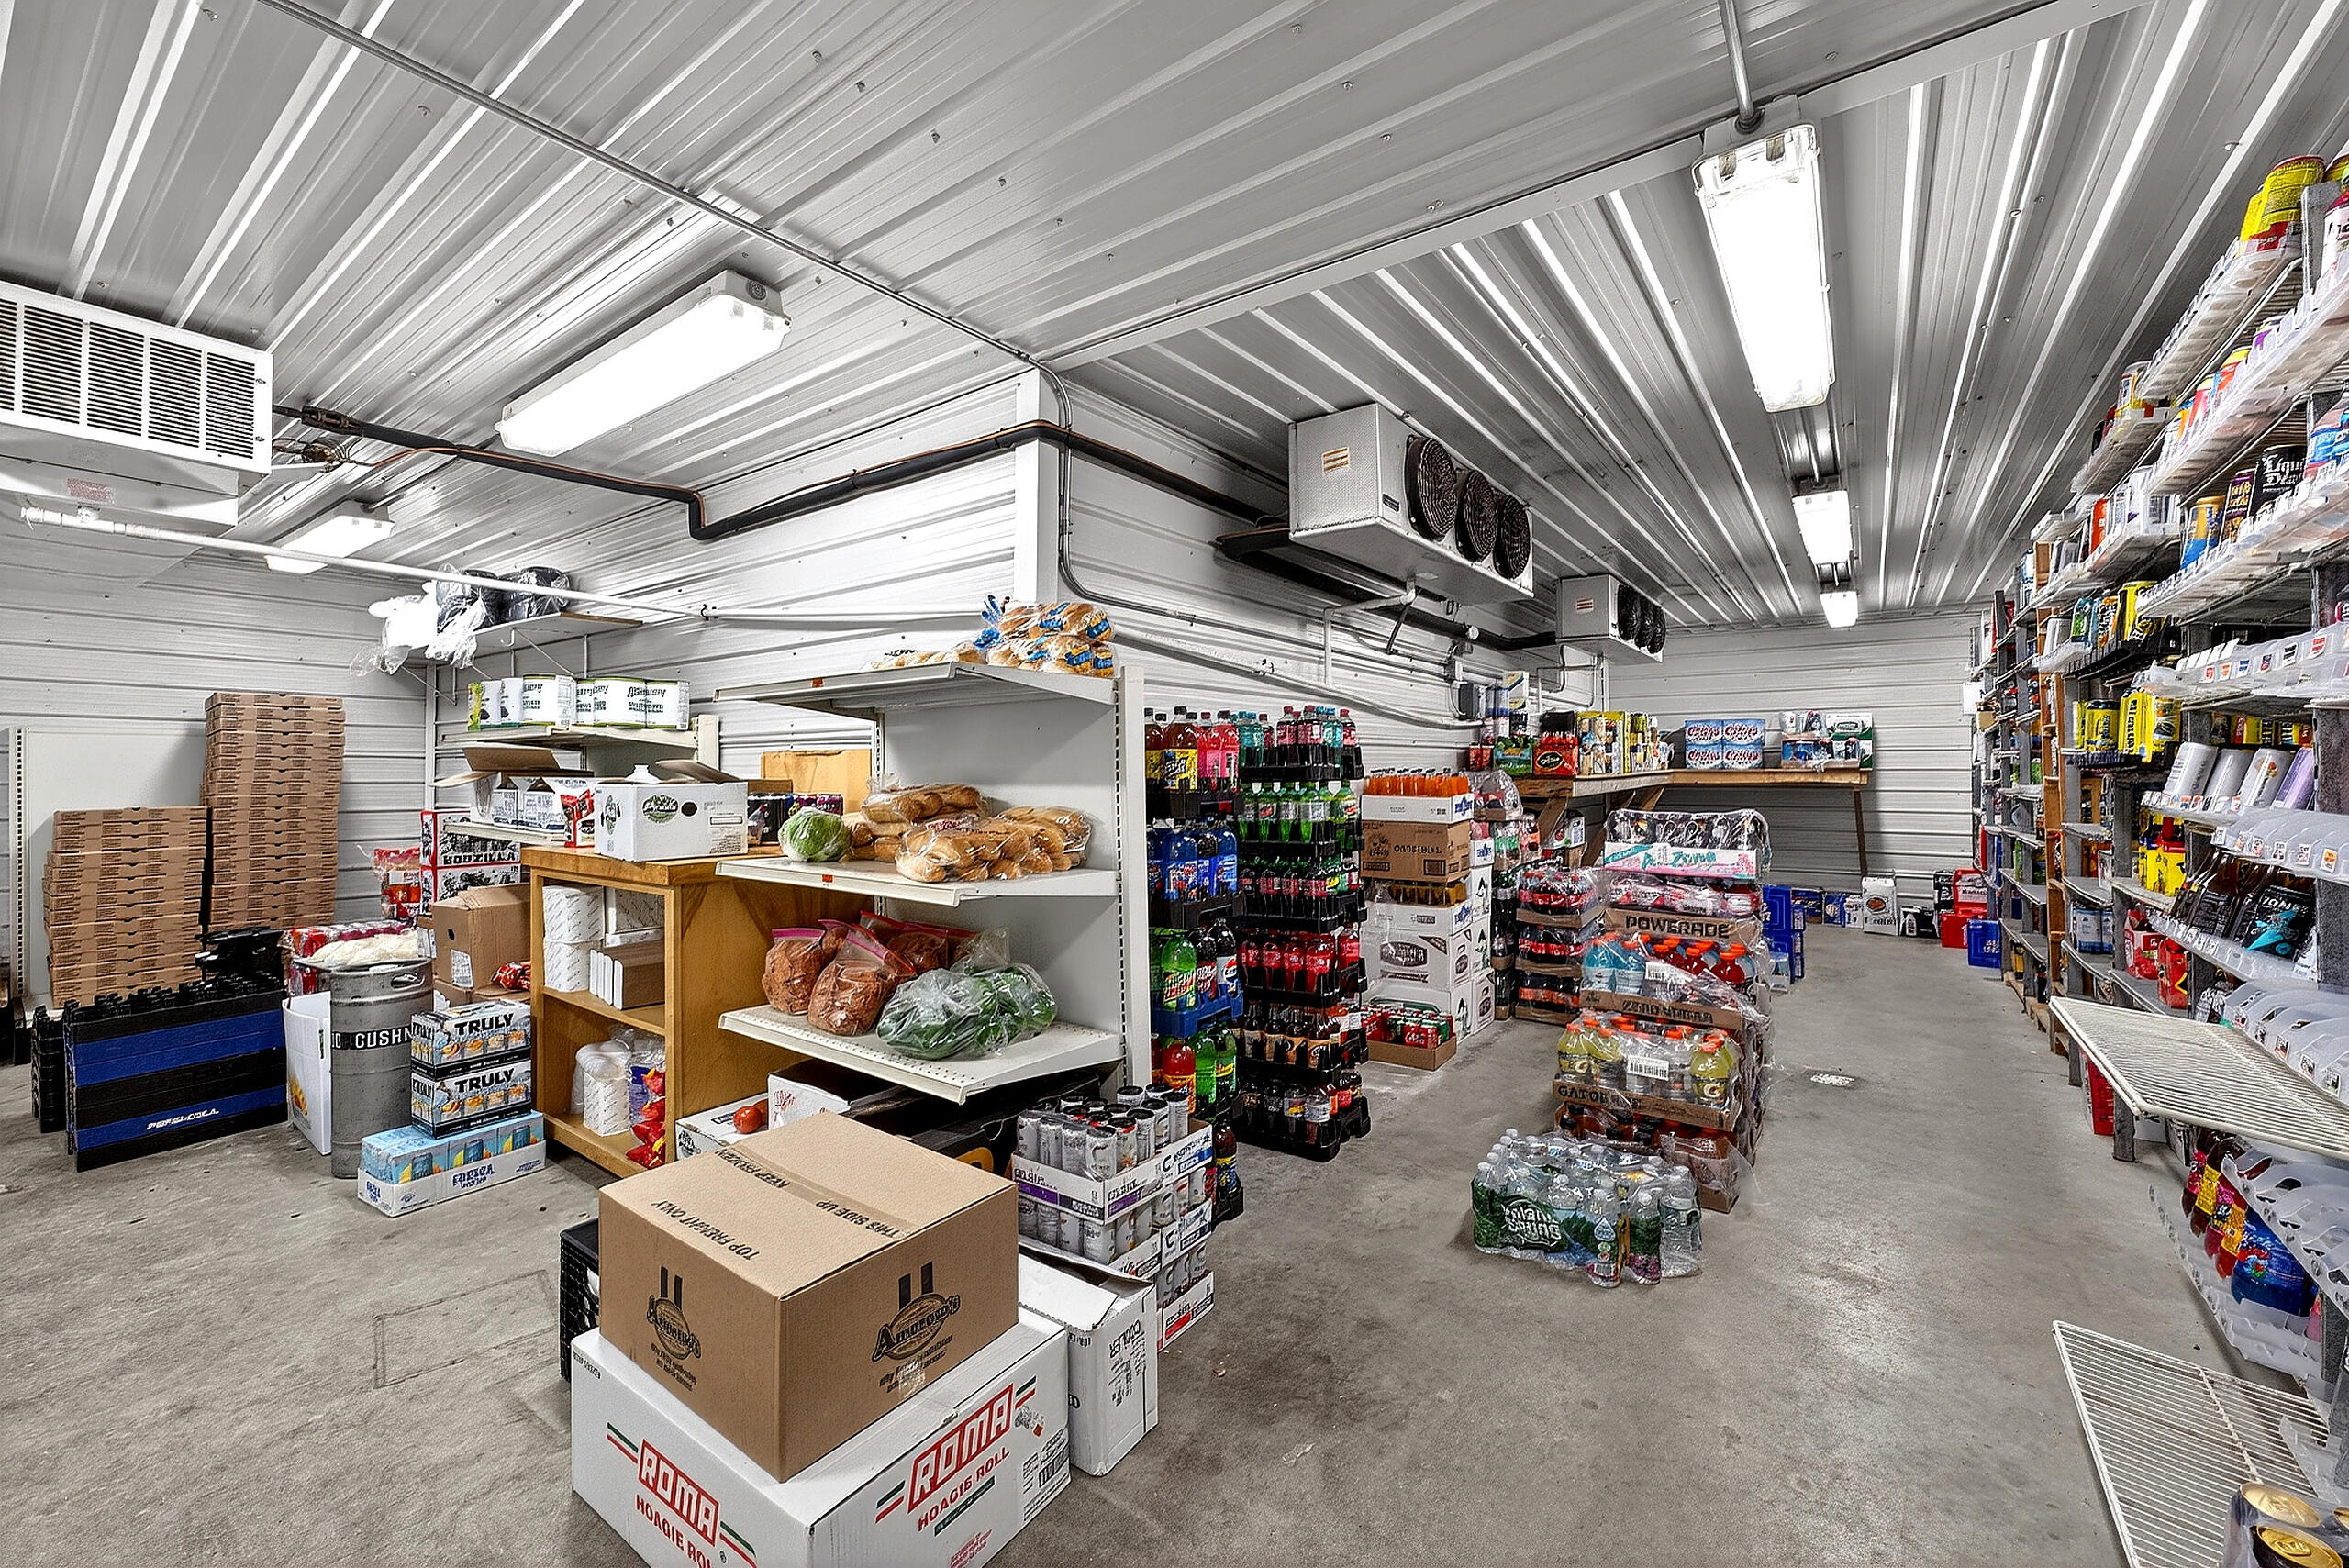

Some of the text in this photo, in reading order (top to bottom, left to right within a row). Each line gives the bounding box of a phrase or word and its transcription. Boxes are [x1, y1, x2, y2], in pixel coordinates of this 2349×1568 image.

[1625, 916, 1730, 939] POWERADE
[454, 1013, 514, 1036] TRULY
[454, 1068, 514, 1093] TRULY
[651, 1199, 760, 1261] TOP FREIGHT ONLY
[815, 1199, 902, 1239] THIS SIDE UP
[913, 1385, 1013, 1511] ROMA
[640, 1446, 719, 1546] ROMA
[918, 1475, 973, 1532] HOAGIE
[975, 1447, 1010, 1482] ROLL
[636, 1494, 684, 1552] HOAGIE
